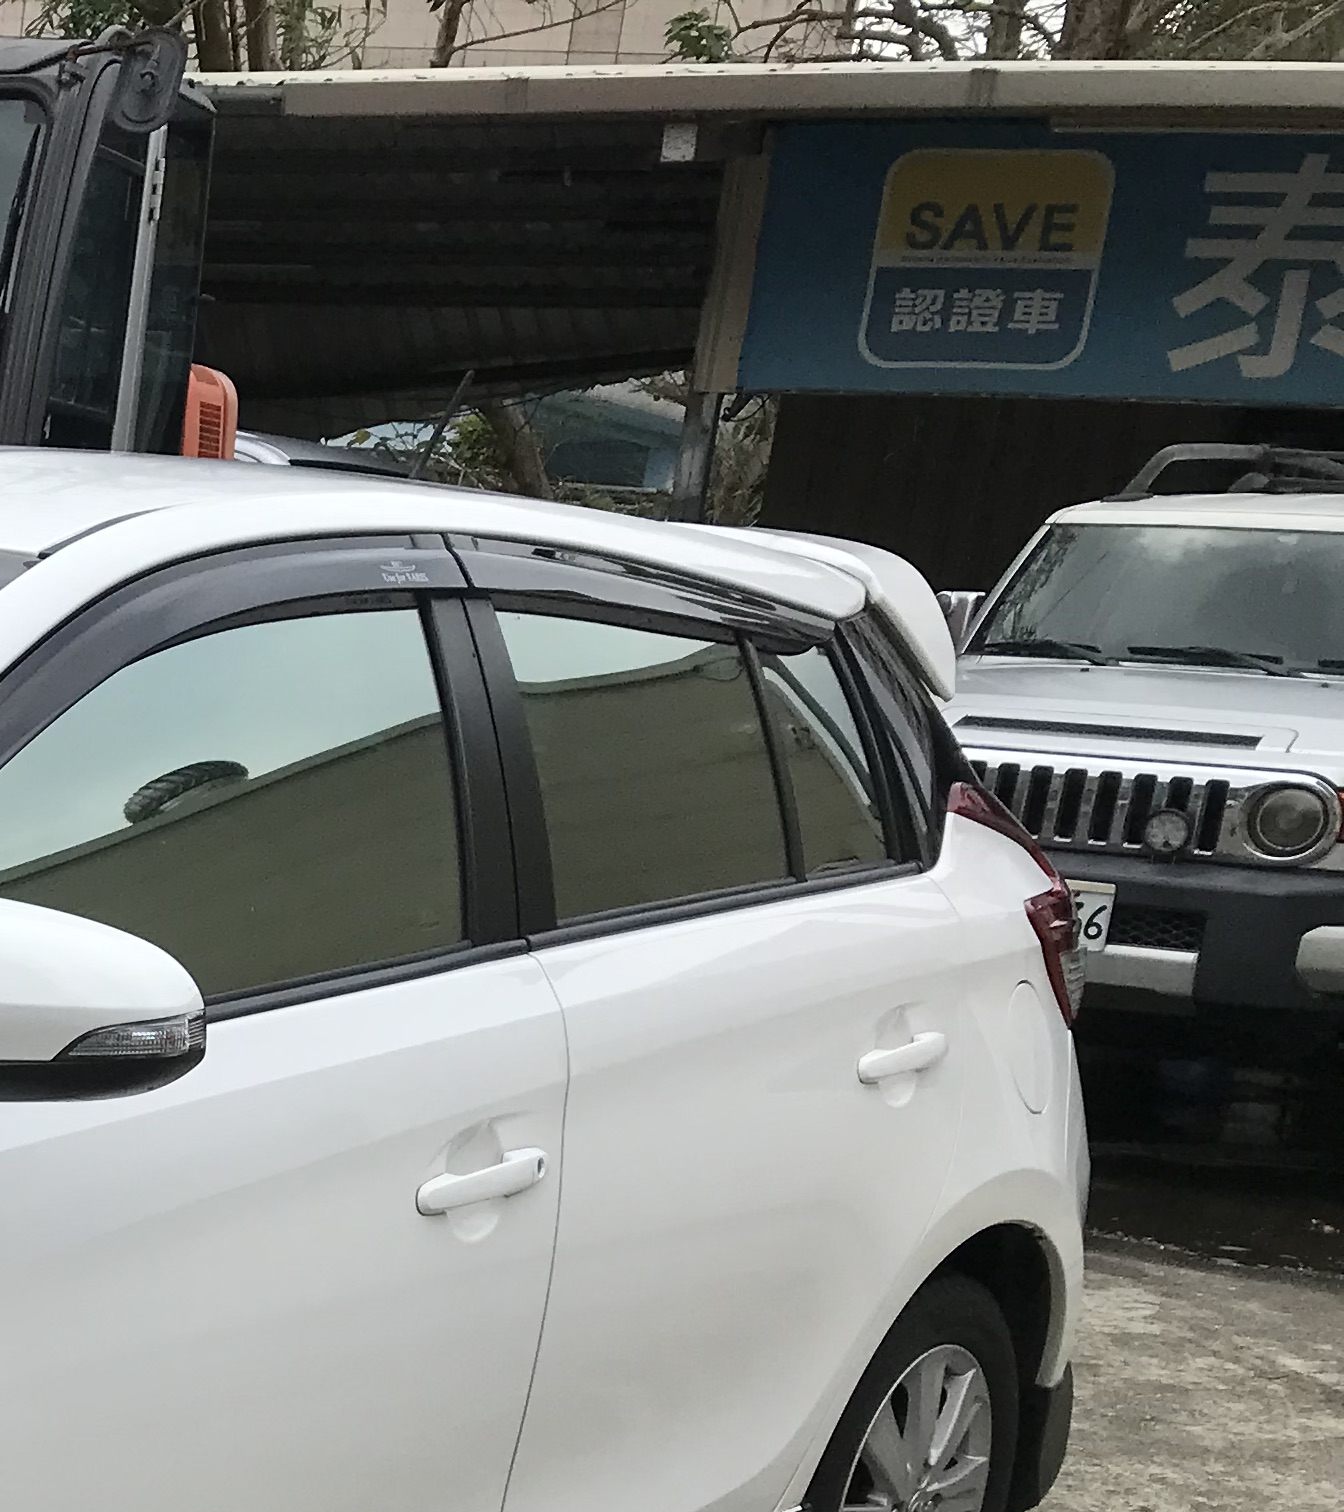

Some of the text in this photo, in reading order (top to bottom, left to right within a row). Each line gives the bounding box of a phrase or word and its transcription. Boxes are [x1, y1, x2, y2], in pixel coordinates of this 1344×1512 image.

[905, 200, 1080, 251] SAVE
[1166, 152, 1344, 379] 泰
[890, 287, 1065, 335] 認證車
[1076, 901, 1108, 940] 6
